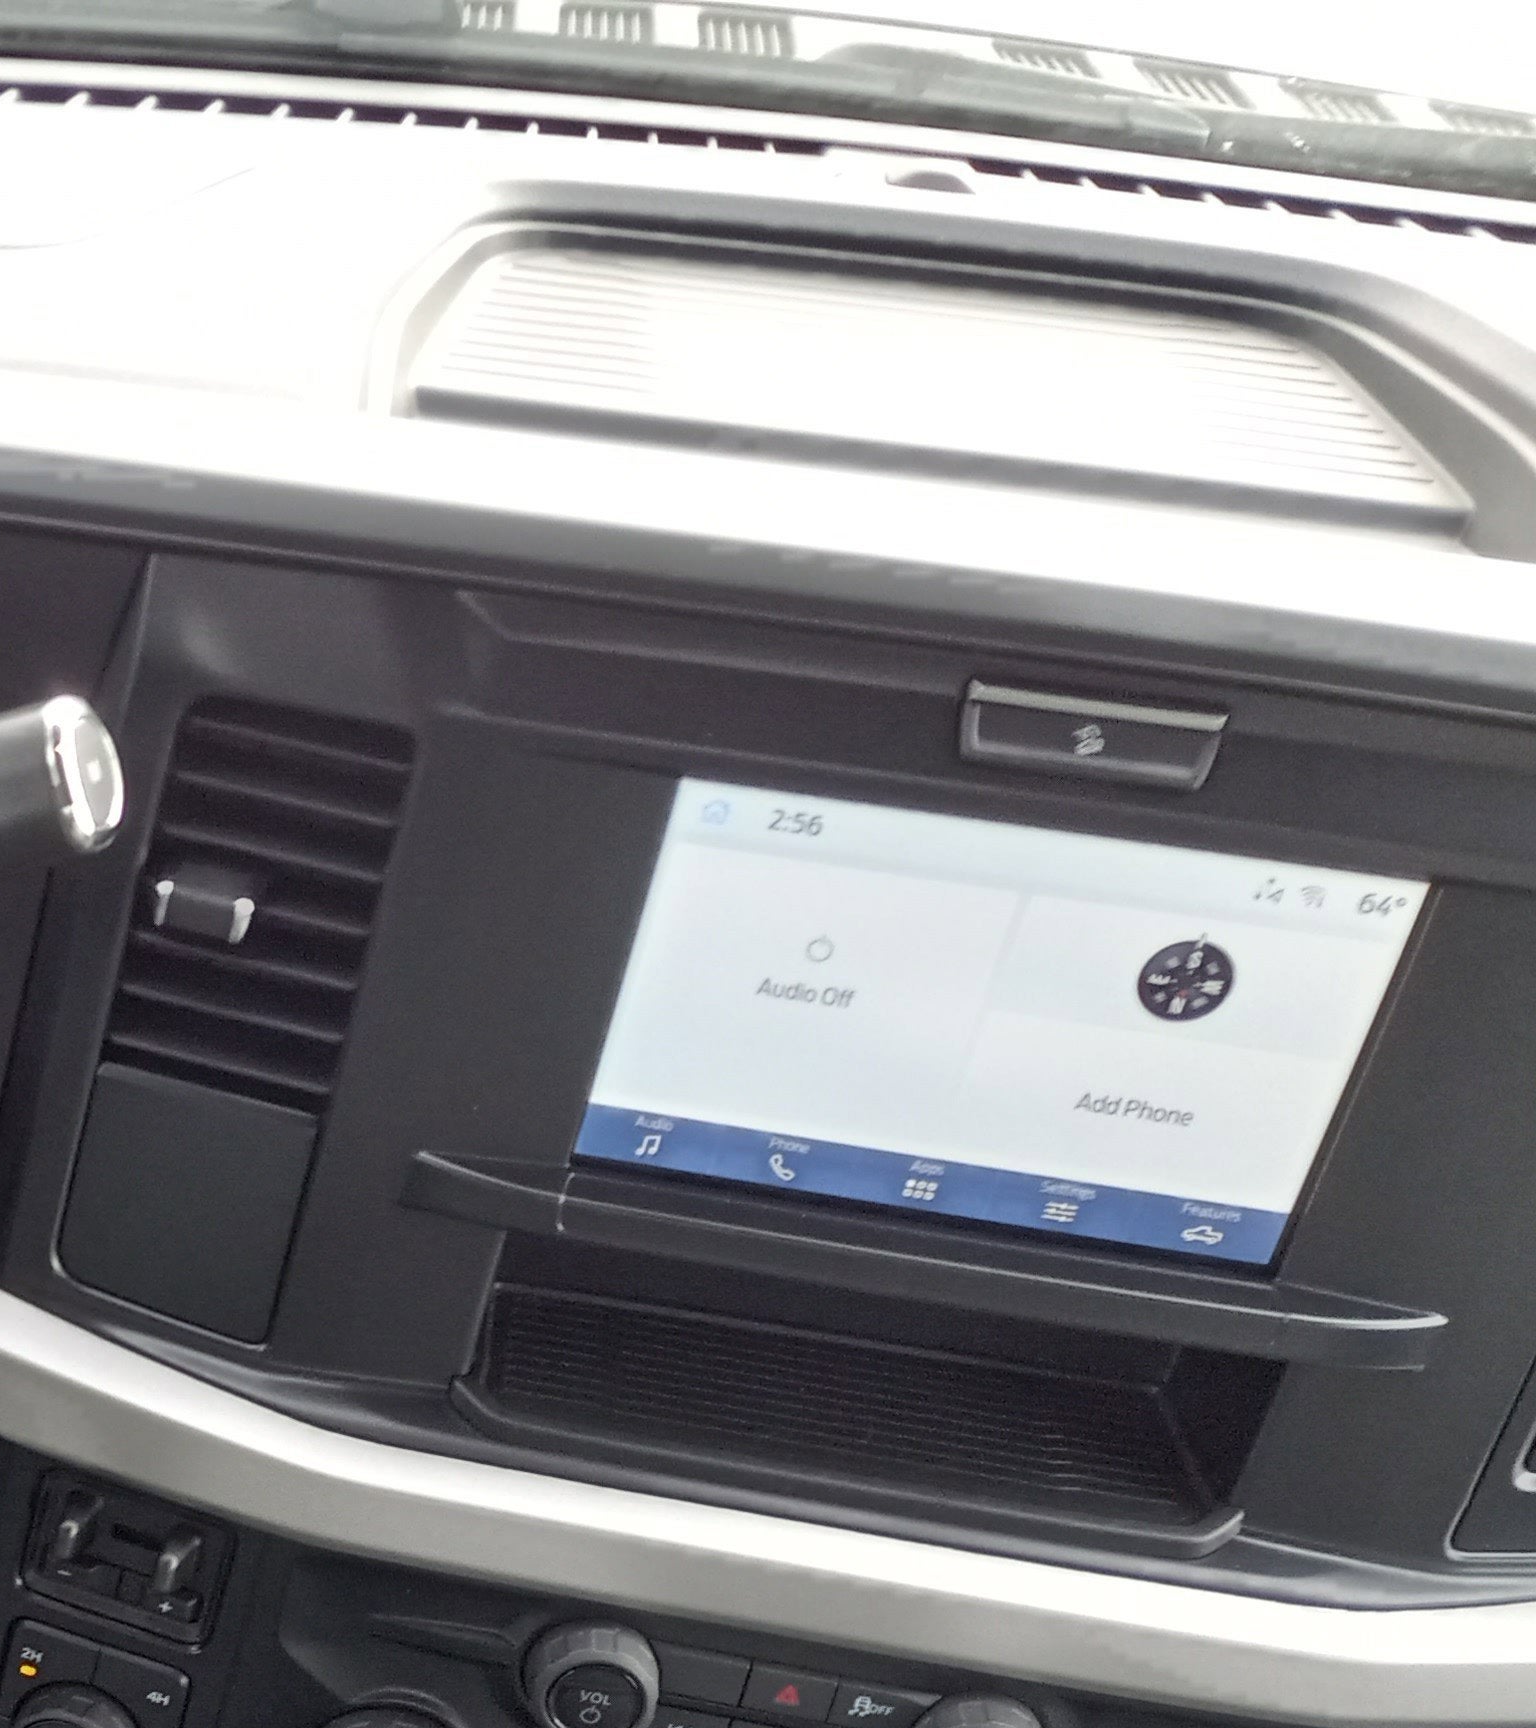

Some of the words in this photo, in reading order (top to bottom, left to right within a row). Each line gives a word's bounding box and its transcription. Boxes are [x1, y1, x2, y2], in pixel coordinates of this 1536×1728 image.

[768, 809, 824, 837] 2:56
[756, 977, 818, 1004] Audio
[821, 986, 856, 1009] Off
[1074, 1092, 1122, 1117] Add
[1123, 1099, 1195, 1128] Phone
[635, 1114, 674, 1133] Audio
[768, 1136, 811, 1155] Phone
[1180, 1202, 1243, 1224] Features
[20, 1647, 44, 1664] 2H
[146, 1691, 171, 1707] 4H
[579, 1689, 612, 1706] VOL
